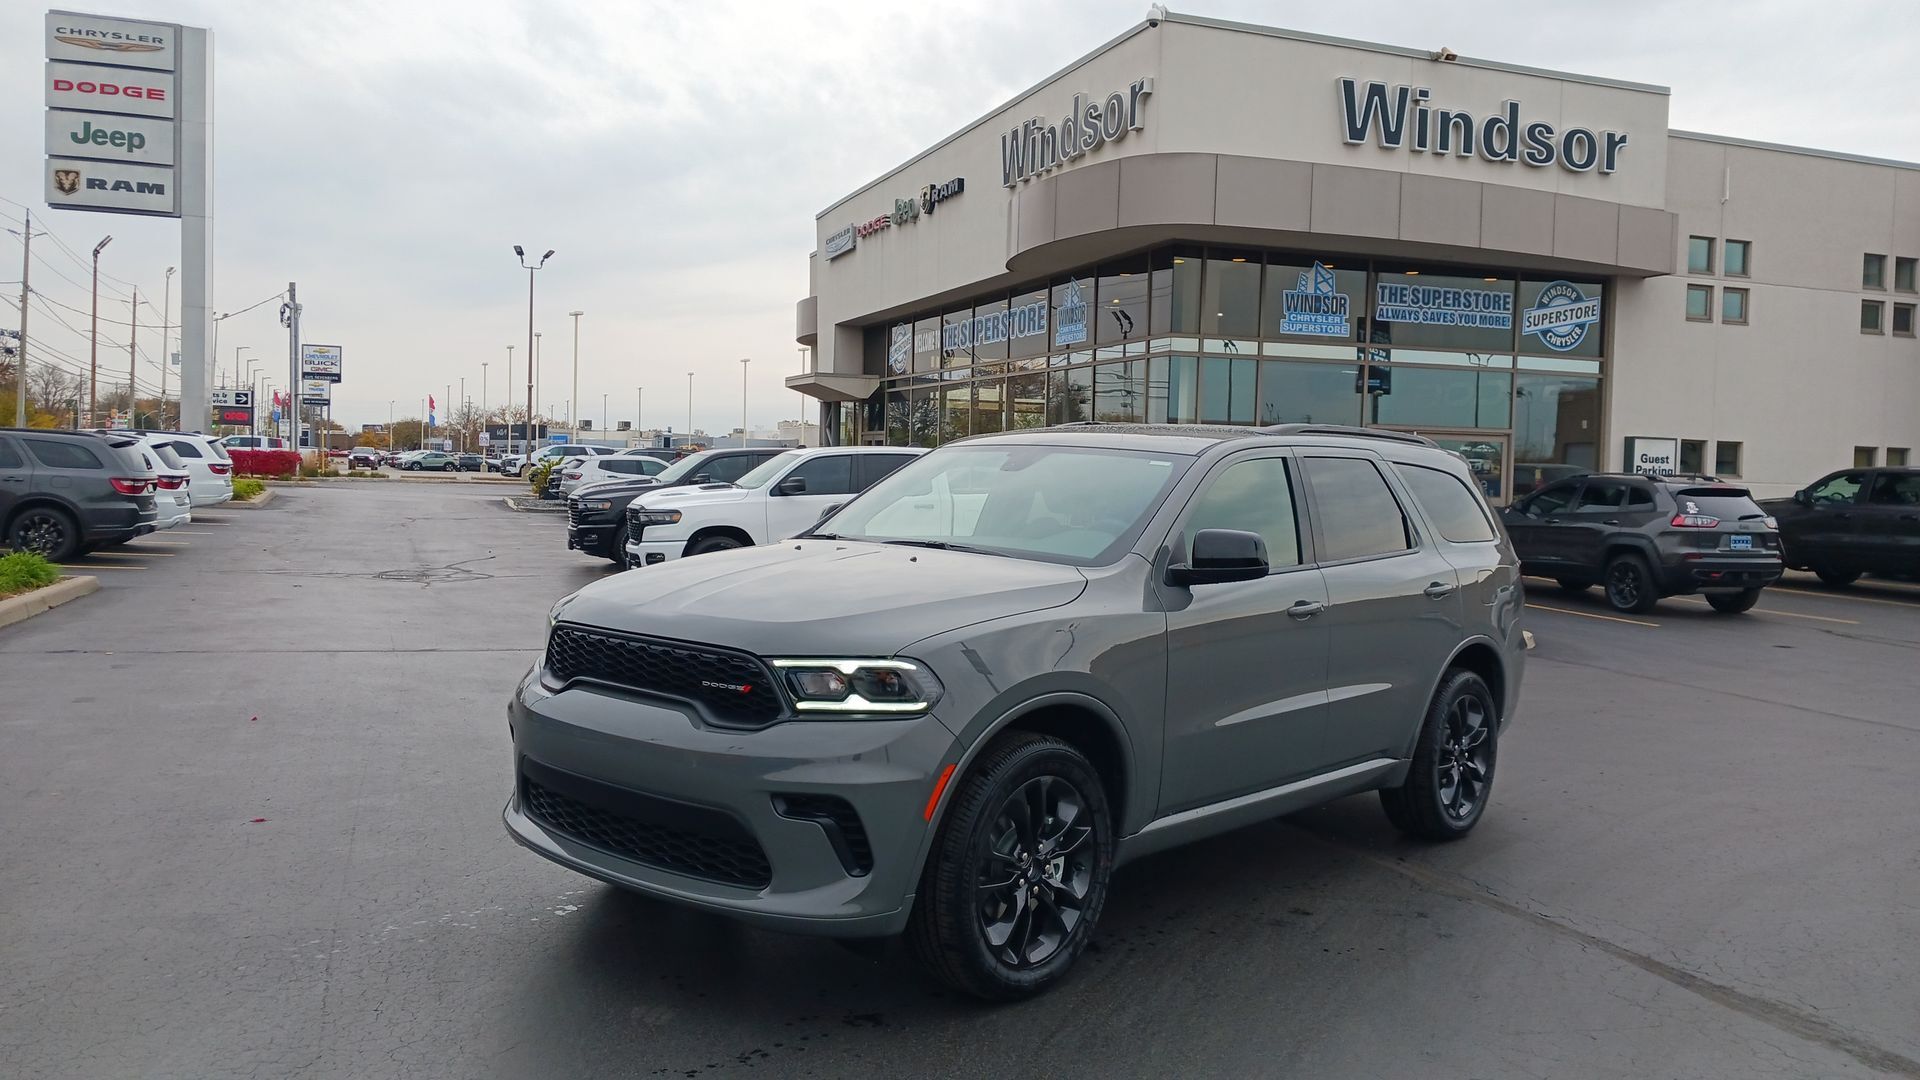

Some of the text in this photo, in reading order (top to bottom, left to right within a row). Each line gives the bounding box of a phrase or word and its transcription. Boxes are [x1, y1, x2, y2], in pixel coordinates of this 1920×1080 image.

[55, 26, 164, 45] CHRYSLER
[53, 79, 165, 101] DODGE
[1001, 77, 1152, 188] Windsor
[1336, 77, 1627, 174] Windsor
[70, 121, 146, 153] Jeep
[86, 177, 165, 195] RAM
[930, 177, 962, 203] RAM
[857, 215, 889, 239] DODGE
[1285, 292, 1347, 316] WINDSOR
[1378, 284, 1512, 312] THE SUPERSTORE
[1541, 286, 1577, 304] WINDSOR
[943, 301, 1047, 349] THE SUPERSTORE
[1290, 314, 1341, 324] CHRYSLER
[1377, 307, 1511, 328] ALWAYS SAVES YOU MORE!
[1526, 304, 1597, 328] SUPERSTORE
[1283, 322, 1347, 334] SUPERSTORE
[1546, 326, 1582, 346] CHRYSLER
[1640, 453, 1670, 464] Guest
[1636, 465, 1673, 476] Parking
[702, 680, 745, 691] DODGE
